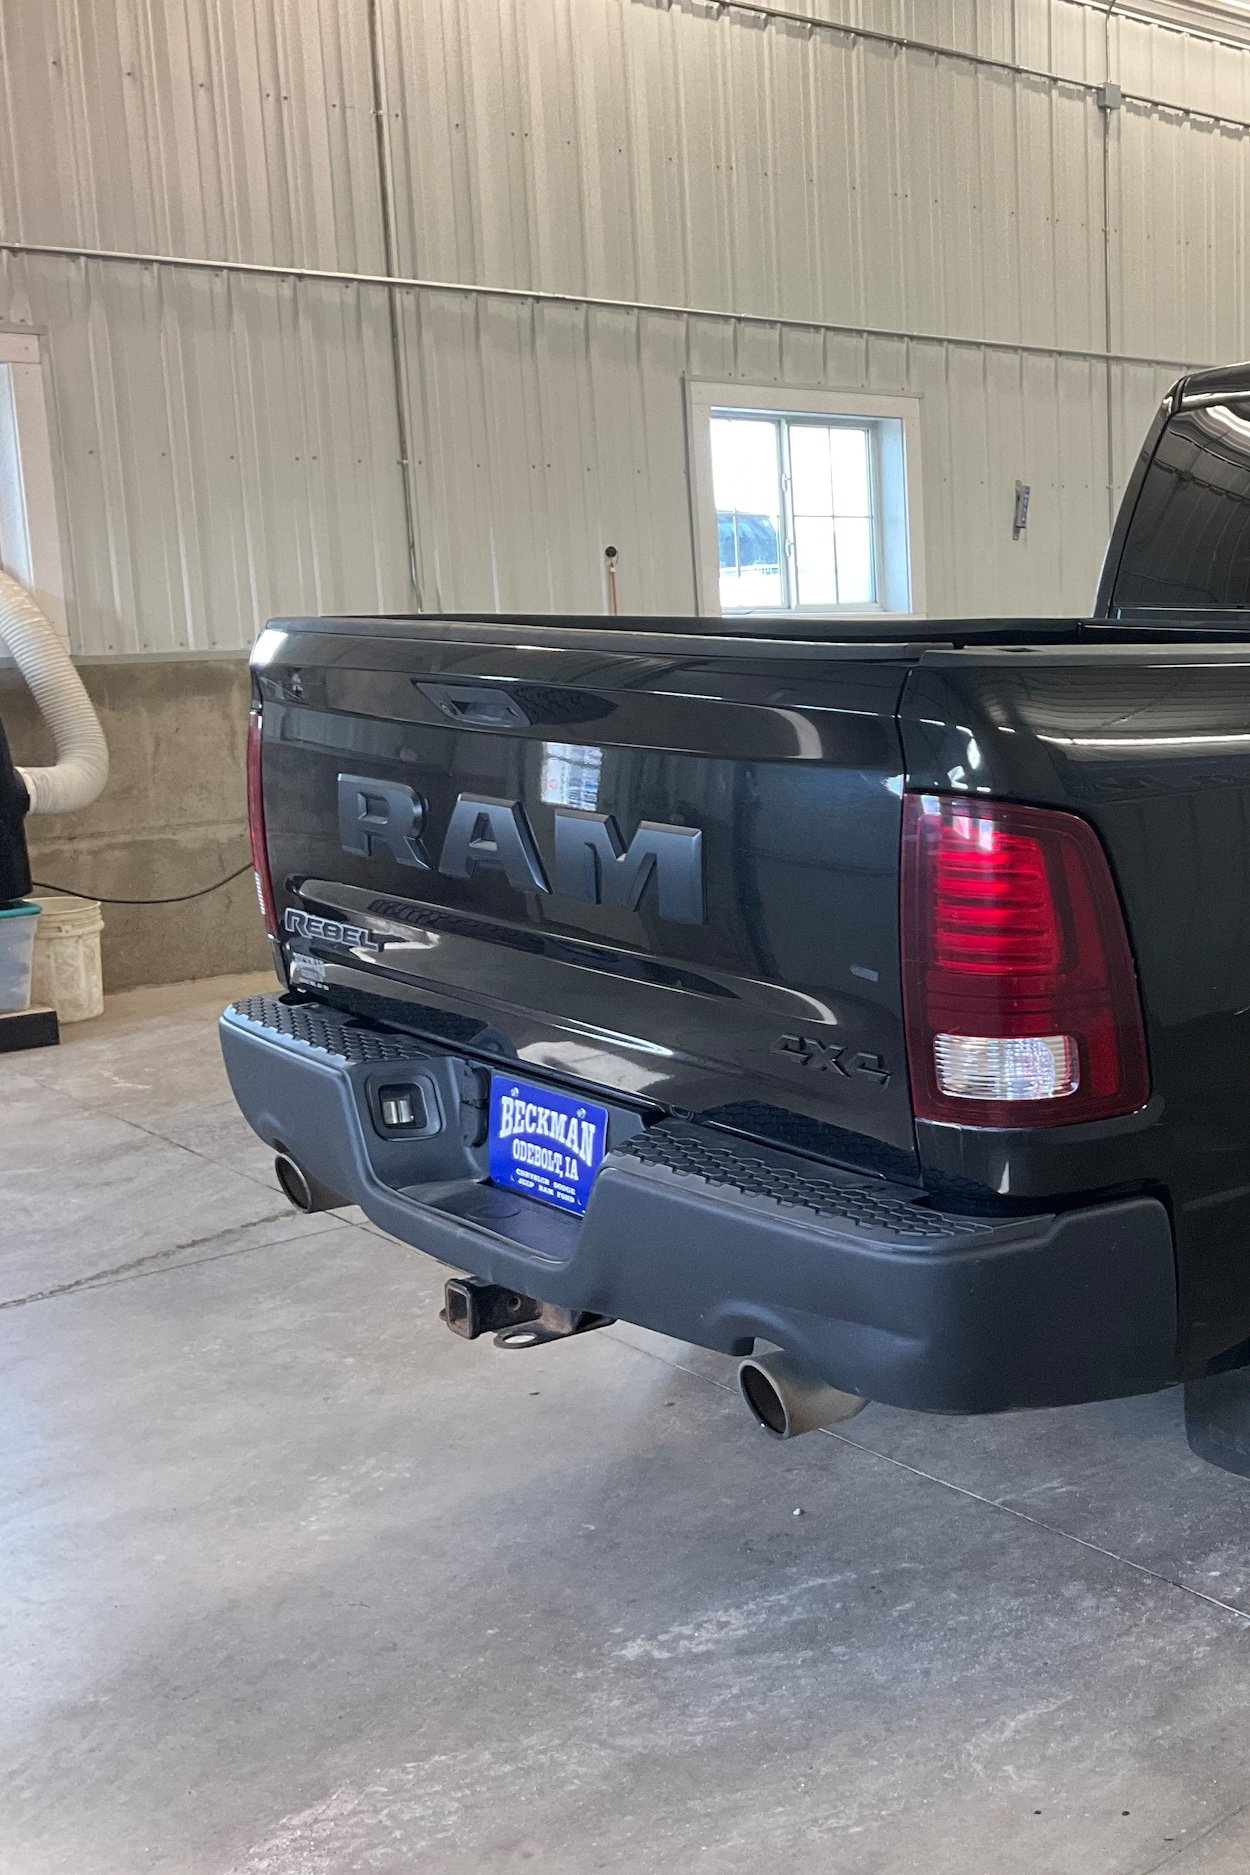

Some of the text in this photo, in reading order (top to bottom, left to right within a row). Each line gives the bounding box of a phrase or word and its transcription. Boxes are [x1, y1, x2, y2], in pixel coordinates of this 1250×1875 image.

[337, 772, 706, 926] RAM
[284, 907, 380, 952] REBEL
[499, 1095, 597, 1168] BECKMAN
[512, 1138, 580, 1181] ODEBOLT, IA
[515, 1168, 576, 1195] CHRYSLER DODGE
[538, 1185, 554, 1196] RAM
[557, 1191, 575, 1203] FORD
